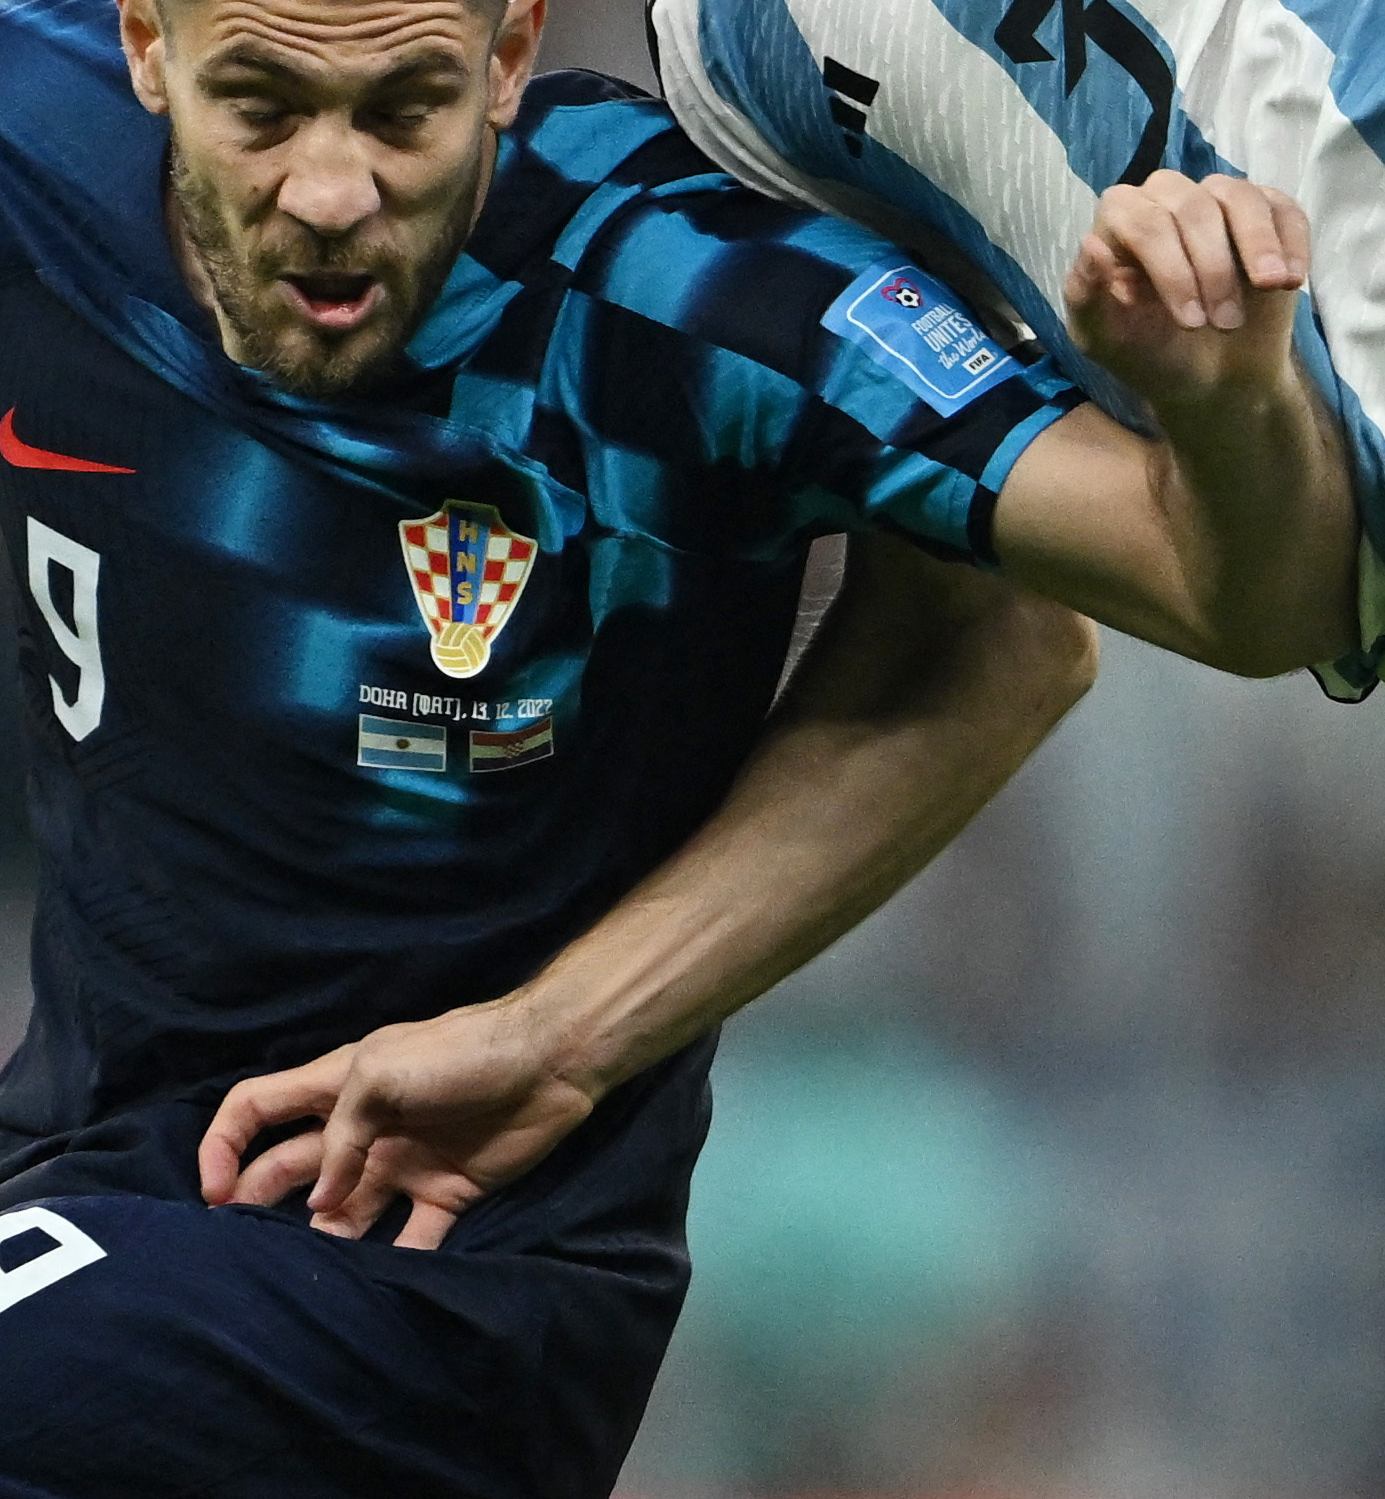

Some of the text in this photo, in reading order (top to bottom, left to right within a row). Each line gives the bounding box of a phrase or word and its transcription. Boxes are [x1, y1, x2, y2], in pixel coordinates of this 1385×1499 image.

[911, 303, 956, 335] FOOTBALL
[923, 312, 973, 352] UNITES
[938, 351, 960, 370] the
[968, 353, 990, 371] FIFA
[27, 515, 105, 742] 9
[359, 684, 408, 710] DOHA
